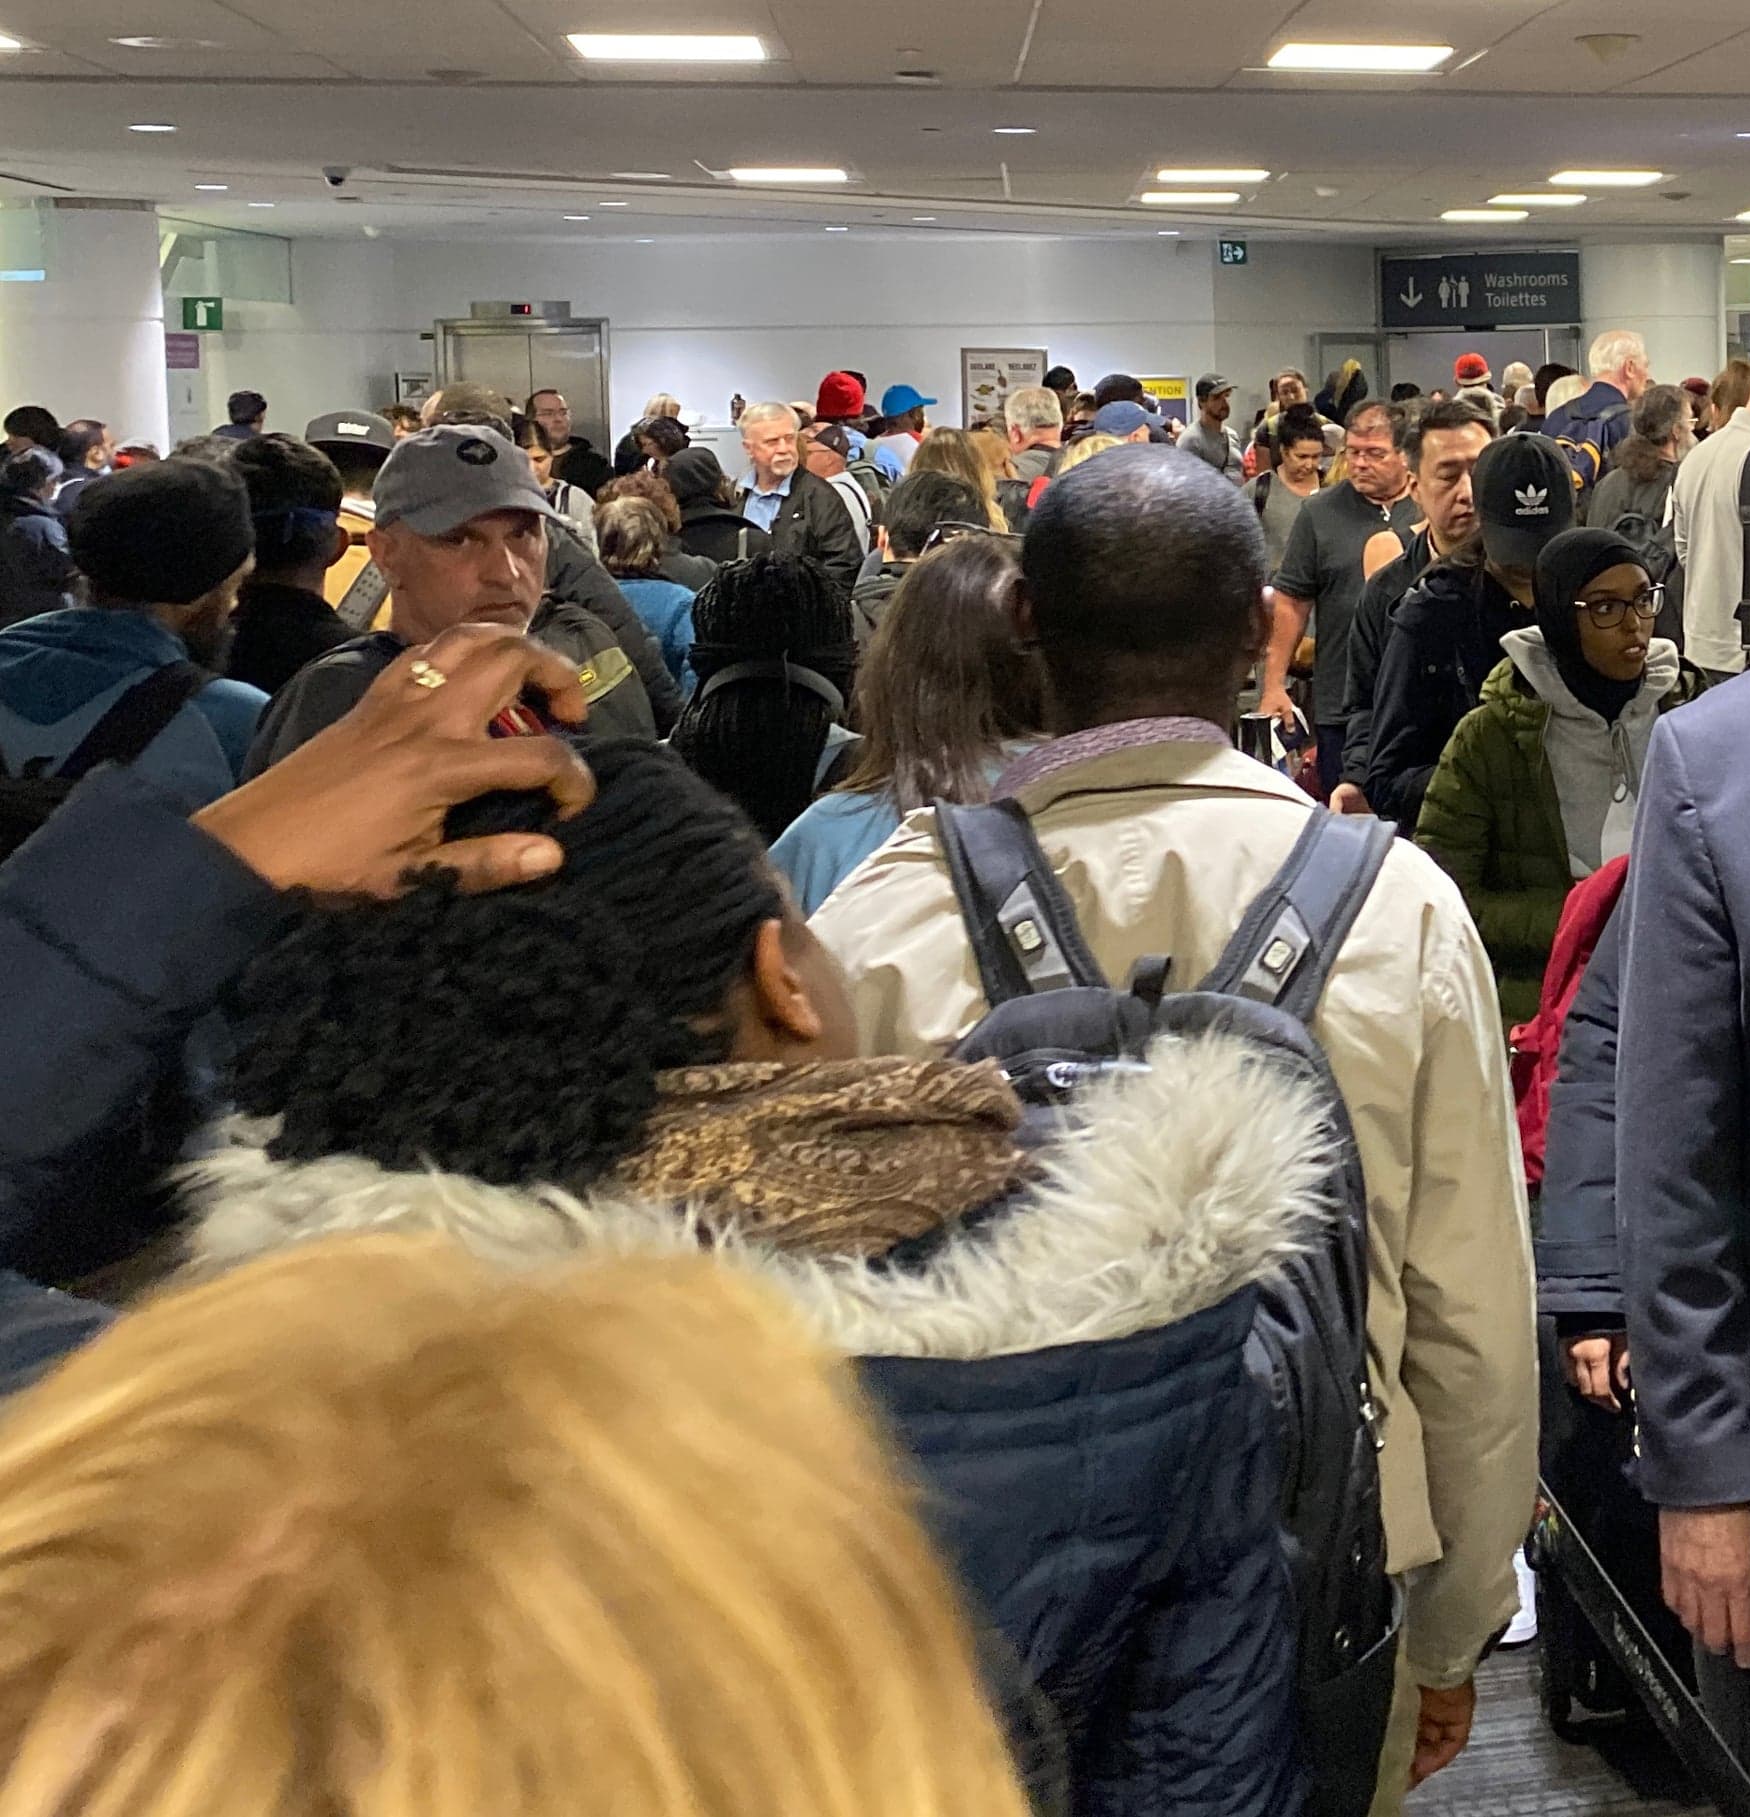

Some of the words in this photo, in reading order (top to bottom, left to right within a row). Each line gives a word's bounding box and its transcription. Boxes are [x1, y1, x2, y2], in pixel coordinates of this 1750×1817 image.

[1484, 273, 1569, 288] Washrooms
[1485, 293, 1548, 308] Toilettes
[1515, 506, 1549, 515] adidas
